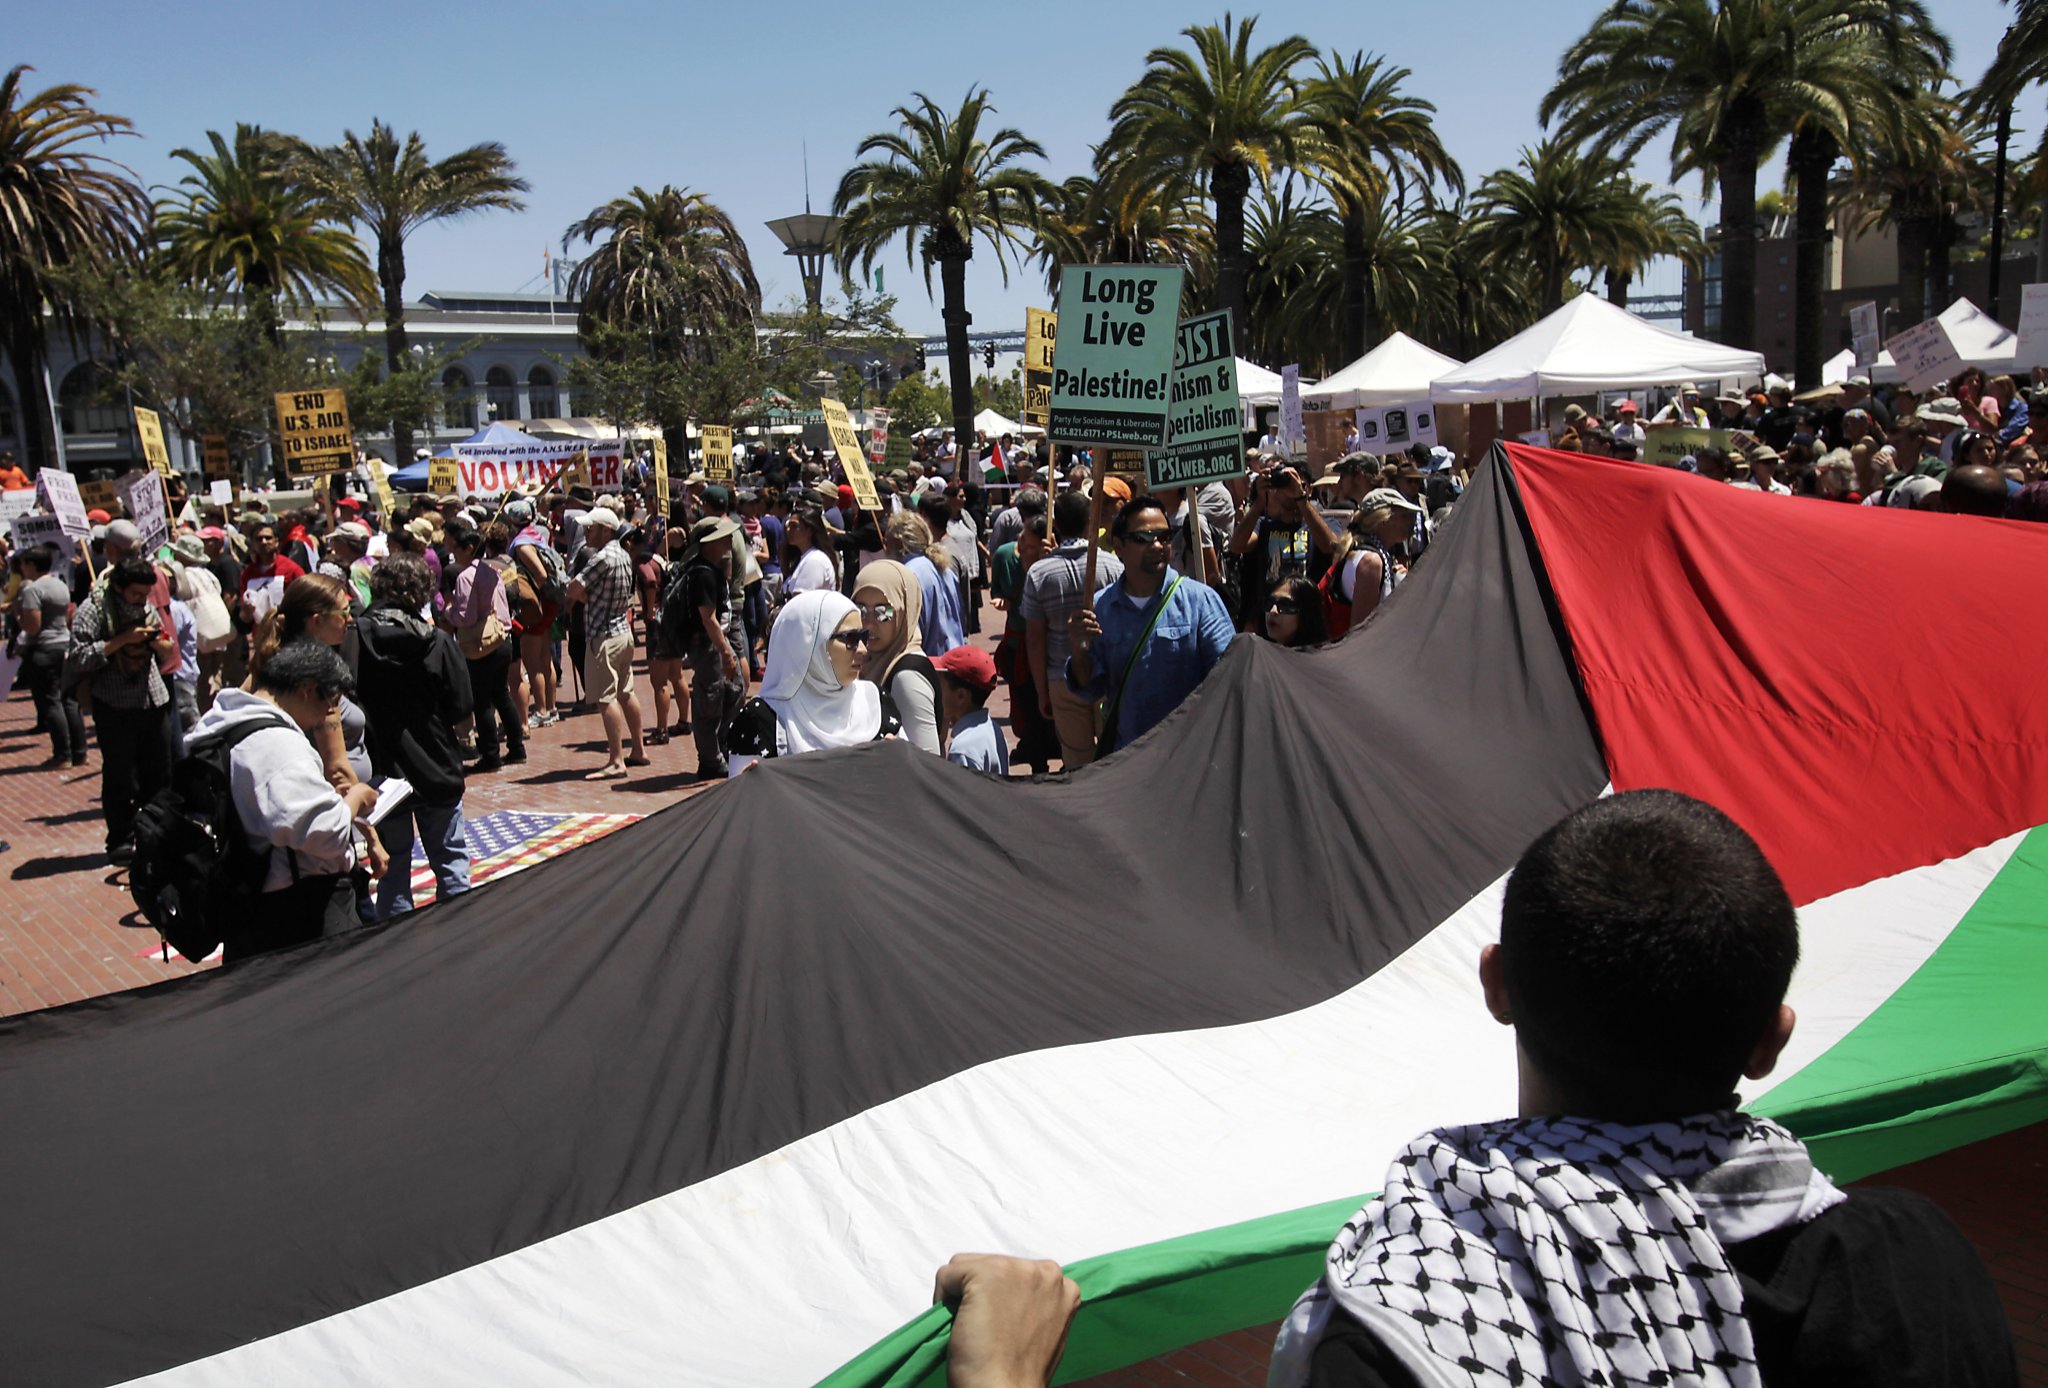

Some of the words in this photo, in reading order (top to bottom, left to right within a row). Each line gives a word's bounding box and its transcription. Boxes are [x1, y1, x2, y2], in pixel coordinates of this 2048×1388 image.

[1082, 271, 1157, 315] Long
[1041, 317, 1055, 340] Lo
[1083, 311, 1145, 346] Live
[1175, 320, 1220, 367] SIST
[1043, 345, 1053, 367] Li
[1054, 368, 1167, 400] Palestine!
[1172, 372, 1212, 403] nism
[1217, 365, 1230, 392] &
[294, 393, 325, 410] END
[1028, 388, 1051, 407] Pal
[285, 415, 314, 431] U.S.
[317, 412, 343, 428] AID
[770, 417, 790, 425] BIKE
[792, 416, 808, 424] THE
[809, 415, 826, 424] PAR
[1054, 415, 1072, 427] Party
[1072, 415, 1082, 425] for
[1082, 416, 1115, 427] Socialism
[1116, 418, 1121, 426] &
[1123, 418, 1160, 429] Liberation
[1168, 405, 1237, 443] perialism
[702, 427, 730, 437] PALESTINE
[1054, 427, 1101, 438] 415.821.6171
[1106, 430, 1158, 444] PSLweb.org
[284, 438, 302, 452] TO
[305, 434, 350, 450] ISRAEL
[474, 447, 507, 455] Involved
[509, 446, 526, 454] with
[588, 442, 620, 452] Coalition
[709, 440, 723, 449] WILL
[1149, 449, 1167, 459] PARTY
[1177, 445, 1203, 455] SOCIALISM
[1208, 438, 1239, 450] LIBERATION
[706, 453, 729, 468] WIN!
[1112, 451, 1143, 460] ANSWER
[458, 454, 619, 491] VOLUNTER
[1113, 461, 1143, 470] 415-821-
[136, 480, 156, 502] STOP
[432, 476, 454, 487] WIN!
